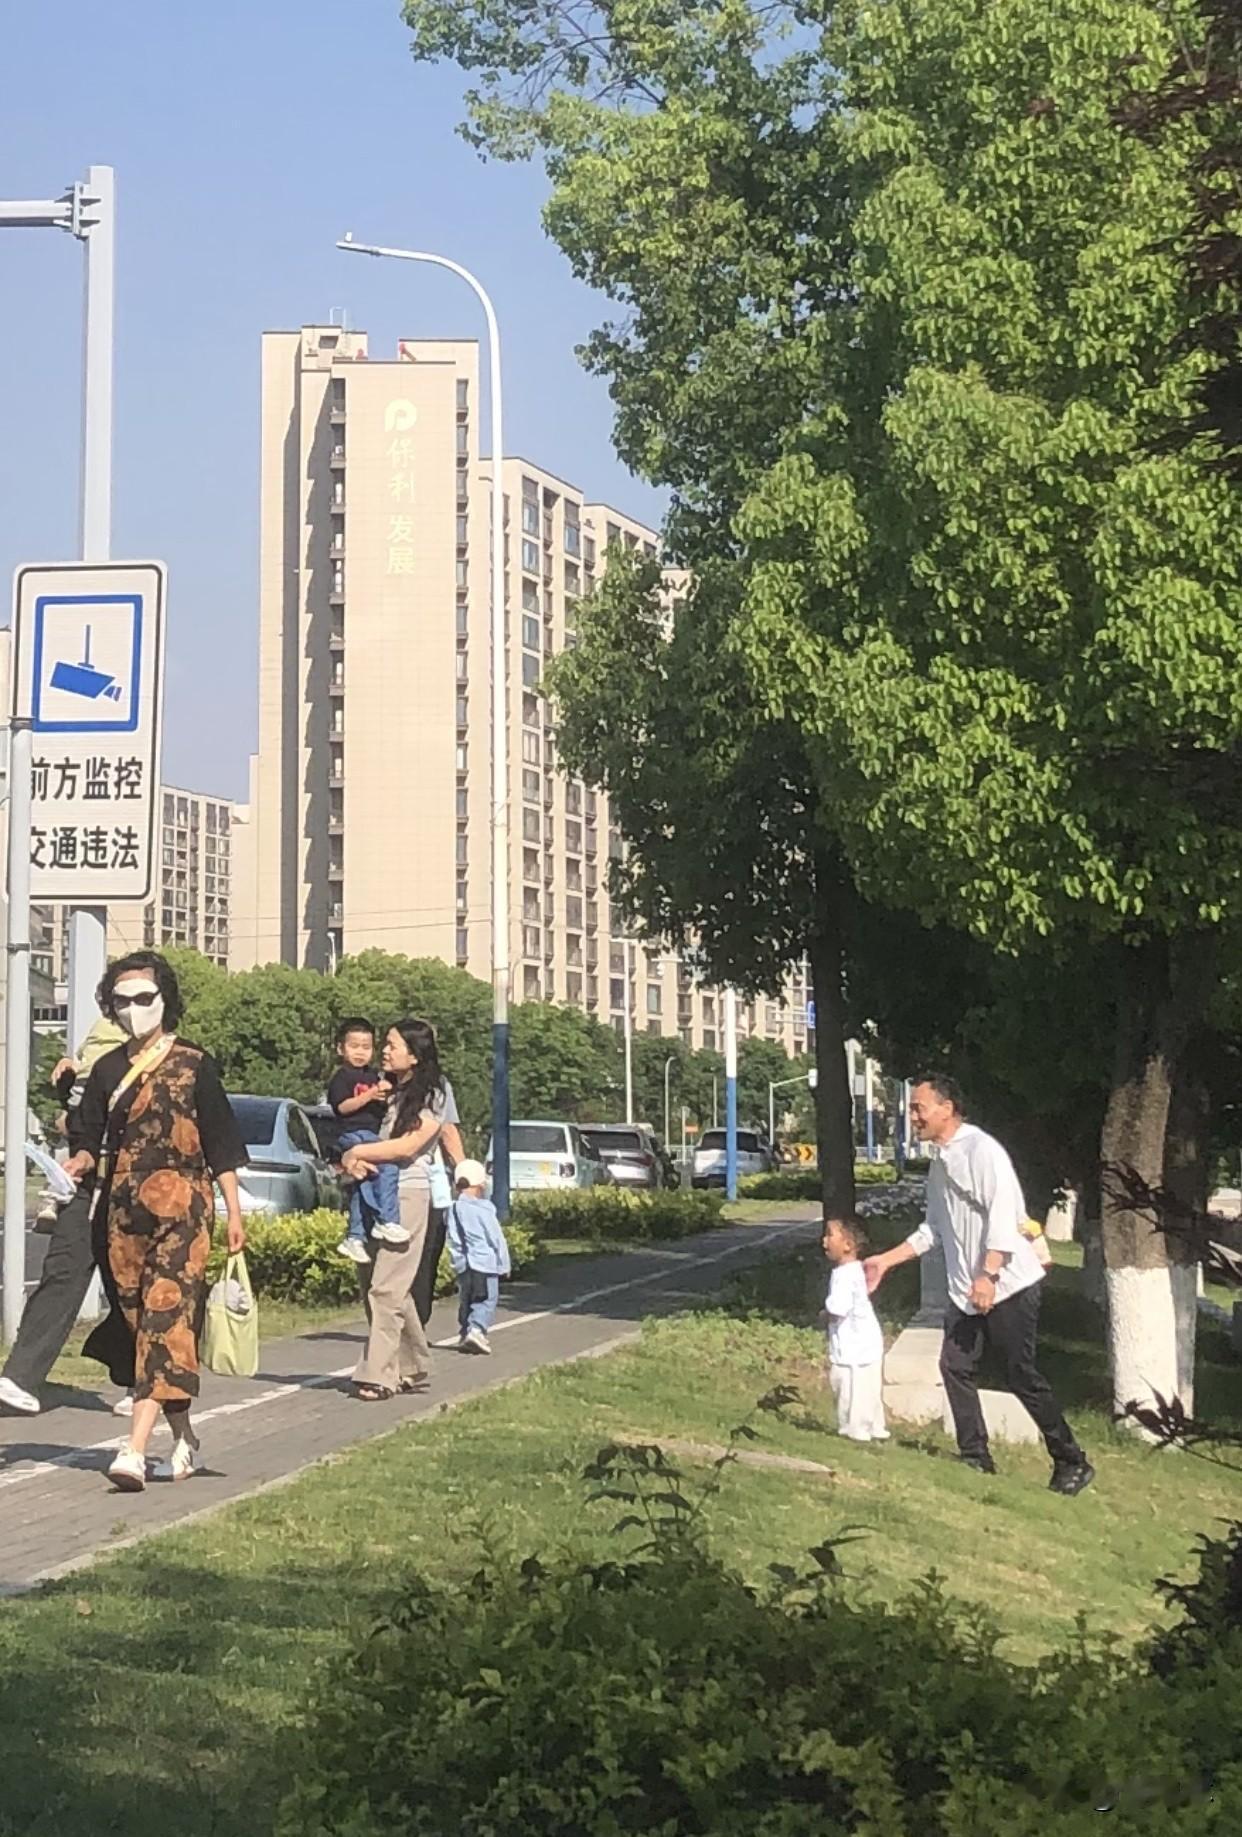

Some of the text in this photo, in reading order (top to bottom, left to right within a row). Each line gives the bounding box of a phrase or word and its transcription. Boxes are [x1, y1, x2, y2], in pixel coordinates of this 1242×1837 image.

[385, 437, 416, 575] 保利发展
[31, 756, 143, 801] 前方监控
